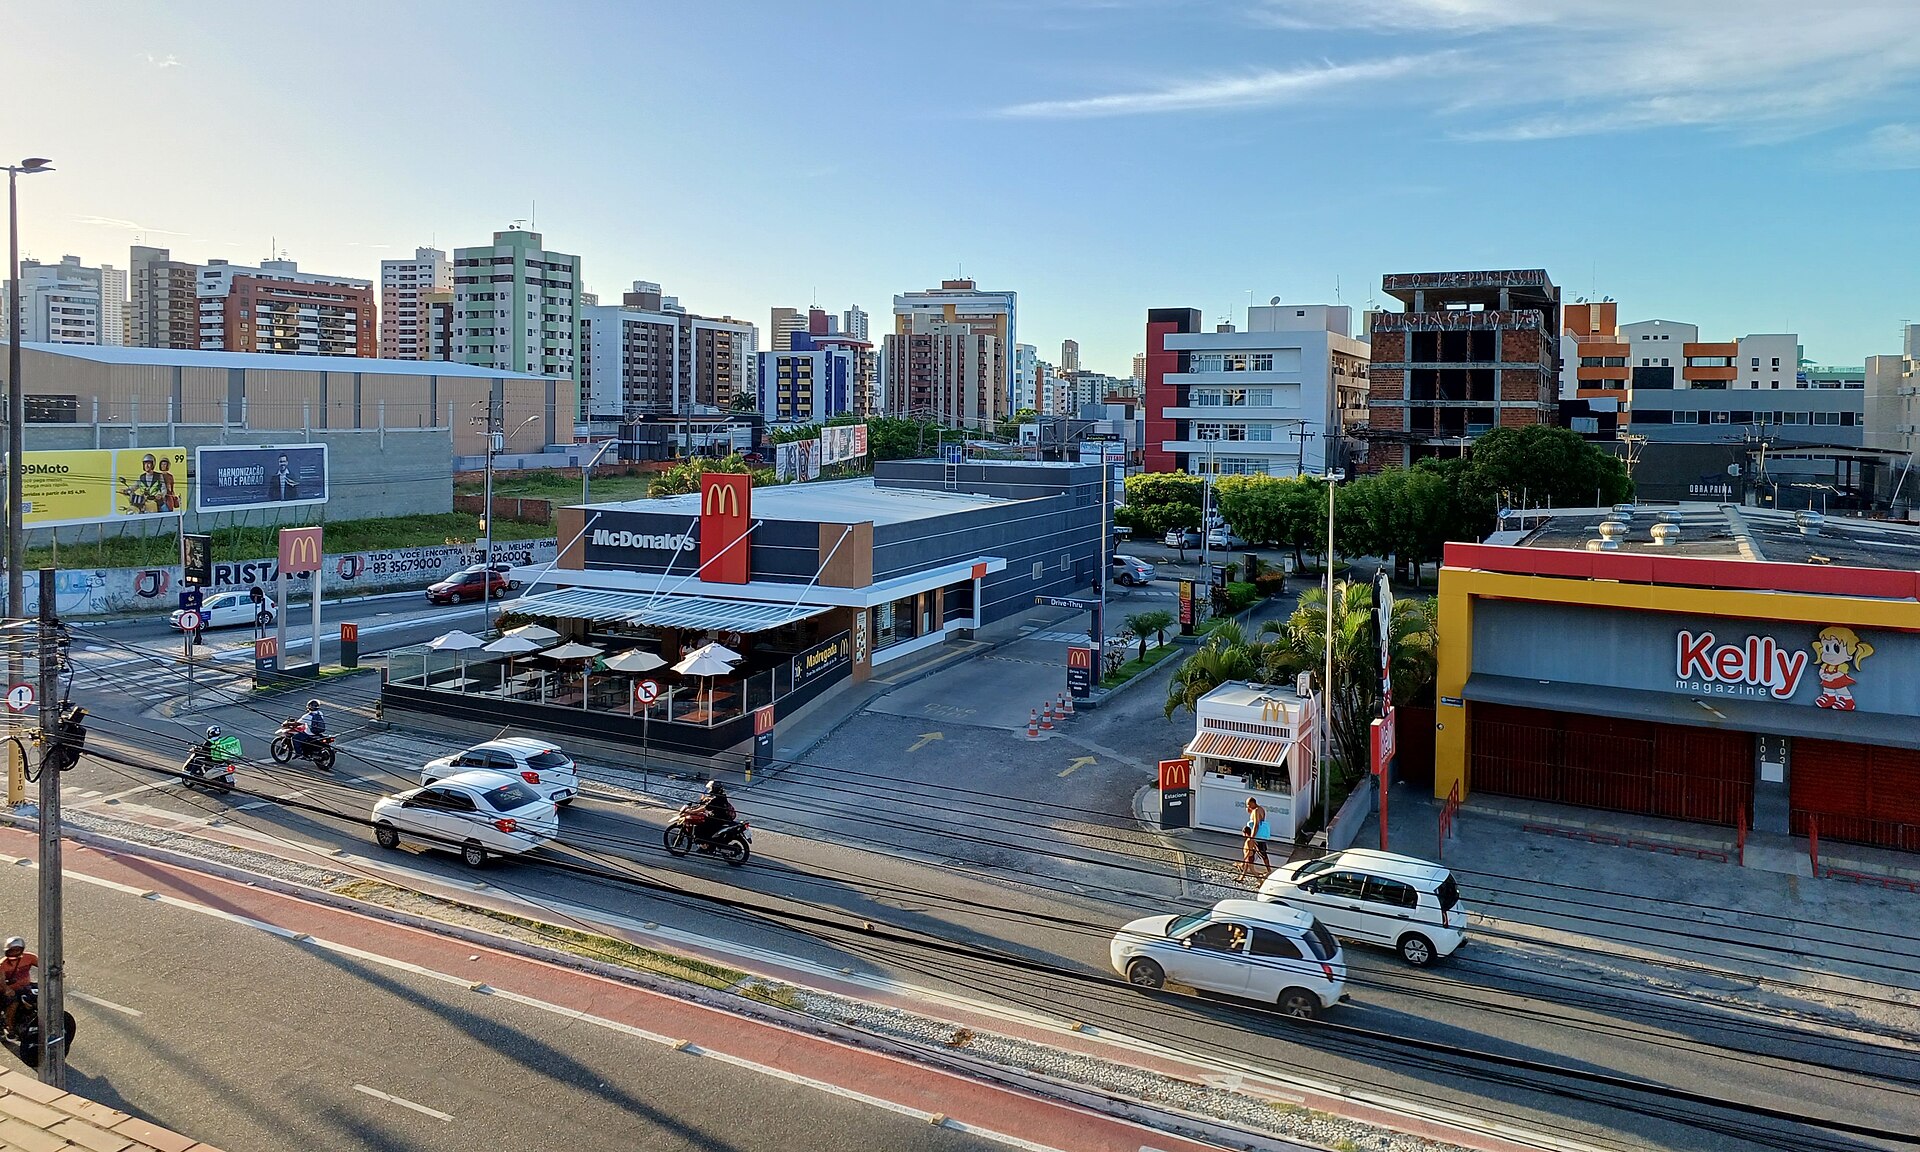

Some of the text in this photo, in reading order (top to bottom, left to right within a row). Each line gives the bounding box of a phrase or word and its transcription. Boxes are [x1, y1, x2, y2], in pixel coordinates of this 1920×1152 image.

[174, 454, 185, 464] 99
[20, 464, 69, 475] 99Moto
[1689, 484, 1708, 494] OBRA
[592, 529, 696, 551] McDonald's
[368, 553, 394, 561] TUDO
[425, 548, 463, 557] ENCONTRA
[508, 542, 535, 551] MELHOR
[389, 557, 442, 573] 35679000
[1050, 598, 1083, 609] Drive-Thru
[805, 642, 838, 669] Madrugada
[1676, 630, 1809, 700] Kelly
[1675, 679, 1767, 697] magazine
